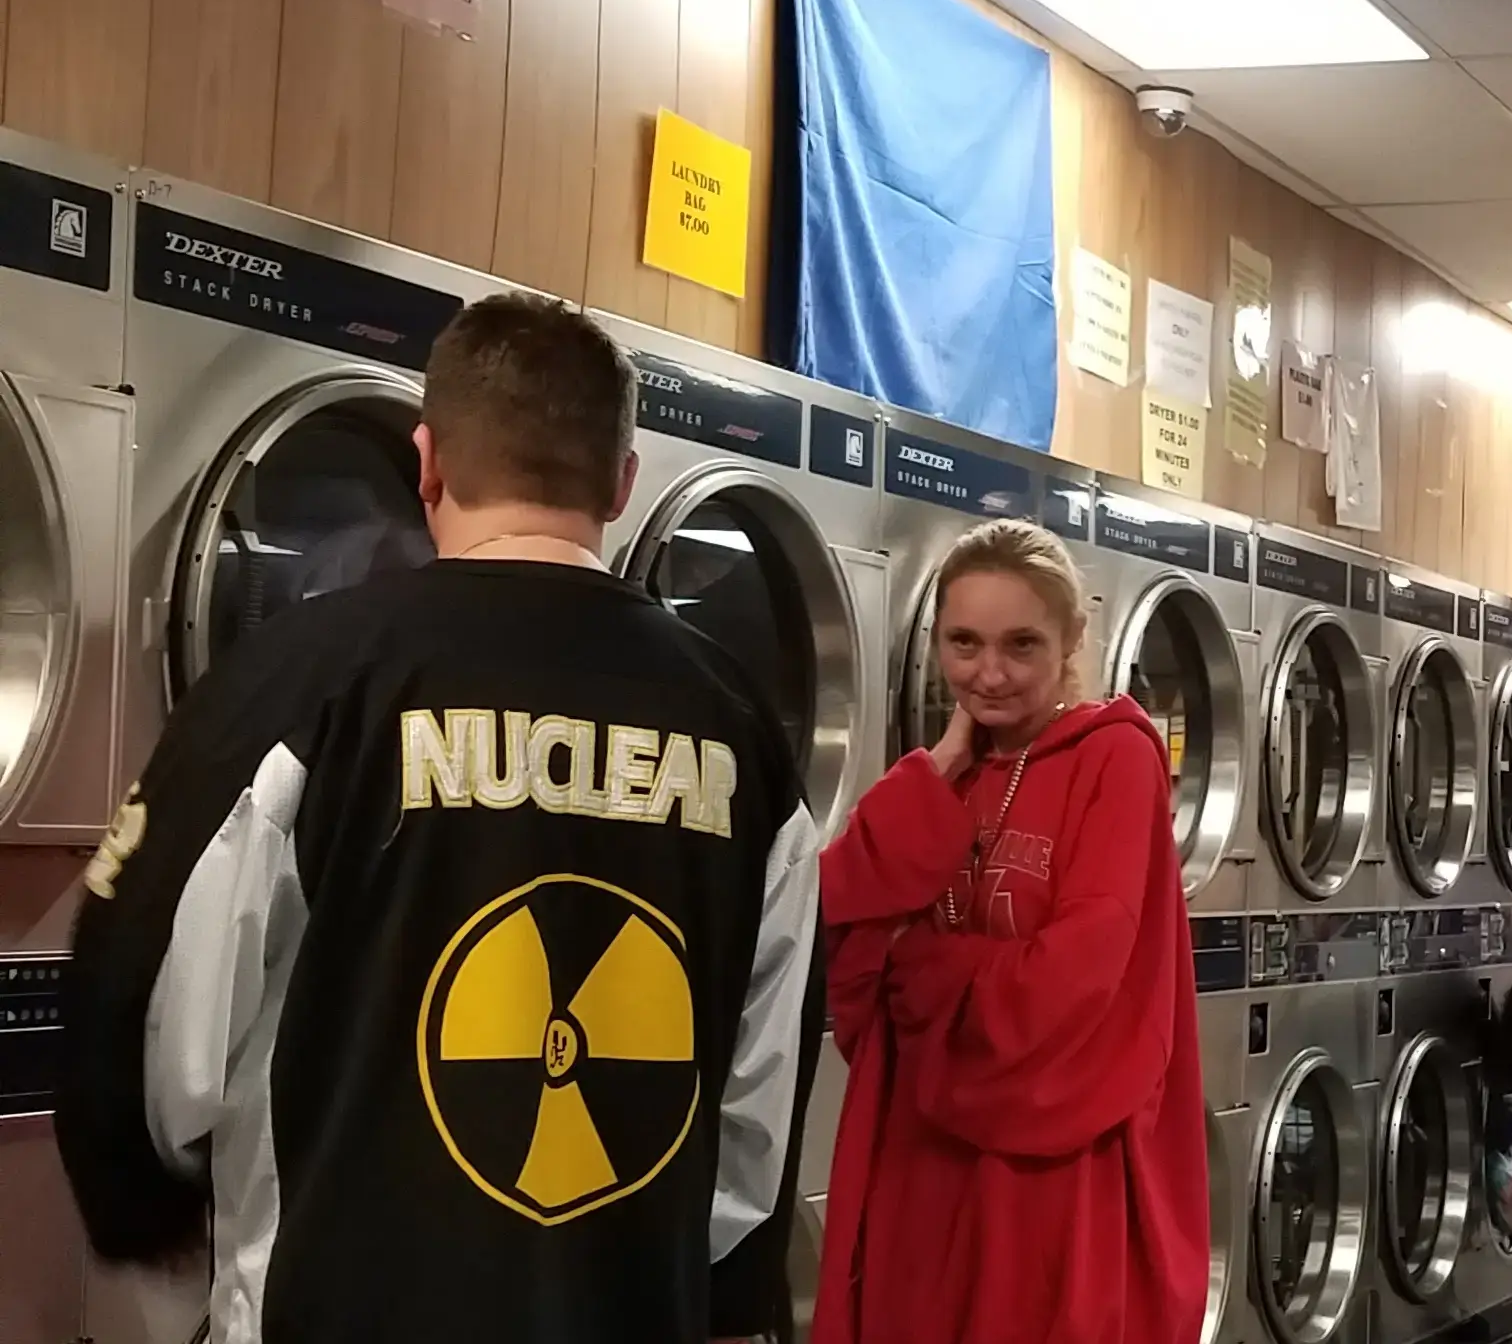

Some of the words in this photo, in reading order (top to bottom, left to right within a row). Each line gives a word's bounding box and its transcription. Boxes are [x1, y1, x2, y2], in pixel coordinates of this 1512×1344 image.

[671, 160, 722, 196] LAUNDRY
[684, 190, 706, 212] BAG
[164, 231, 286, 281] DEXTER
[163, 269, 232, 301] STACK
[249, 293, 313, 323] DRYER
[636, 369, 684, 394] XTER
[658, 404, 703, 427] DRYER
[1159, 427, 1176, 444] FOR
[898, 445, 956, 473] DEXTER
[897, 470, 931, 489] STACK
[936, 481, 969, 499] DRYER
[400, 708, 737, 839] NUCLEAR
